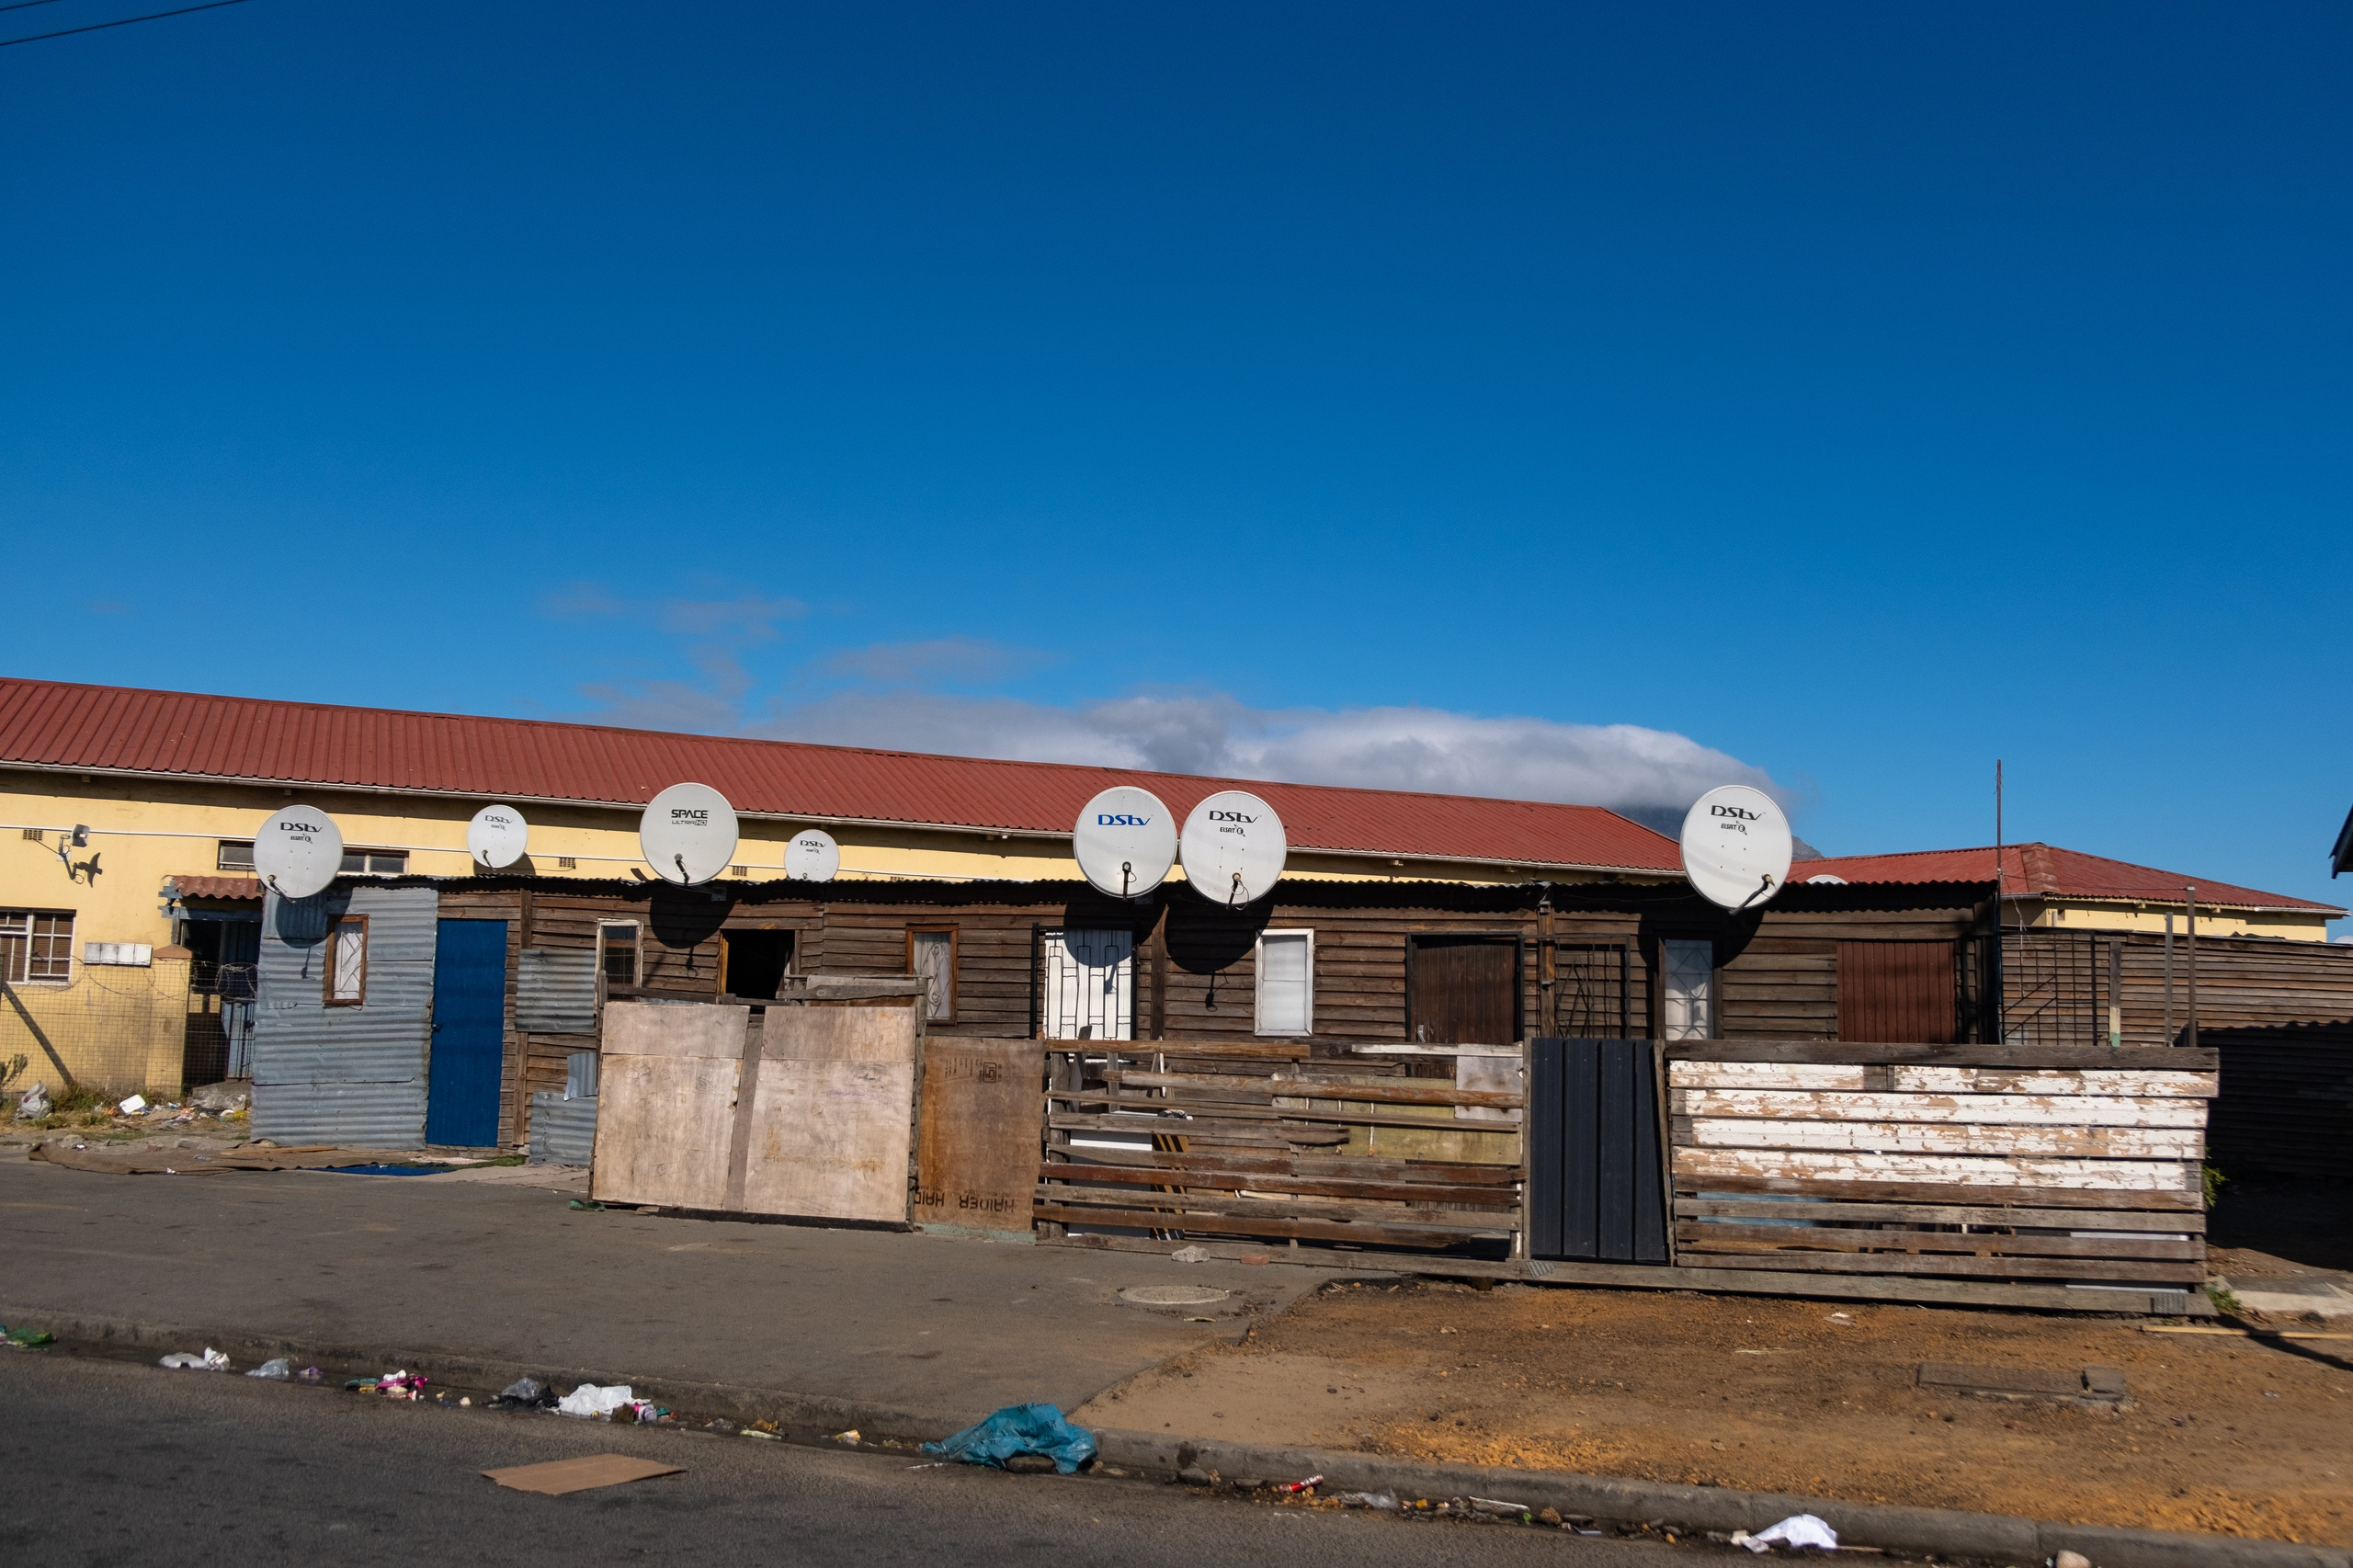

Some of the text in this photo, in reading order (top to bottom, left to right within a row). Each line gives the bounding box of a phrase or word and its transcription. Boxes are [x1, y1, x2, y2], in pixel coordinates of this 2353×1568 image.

[671, 809, 709, 819] SPACE
[1209, 810, 1258, 824] DStv
[1711, 805, 1762, 821] DStv
[484, 814, 513, 824] DStv
[1097, 814, 1151, 825] DStv
[280, 823, 322, 833] DStv
